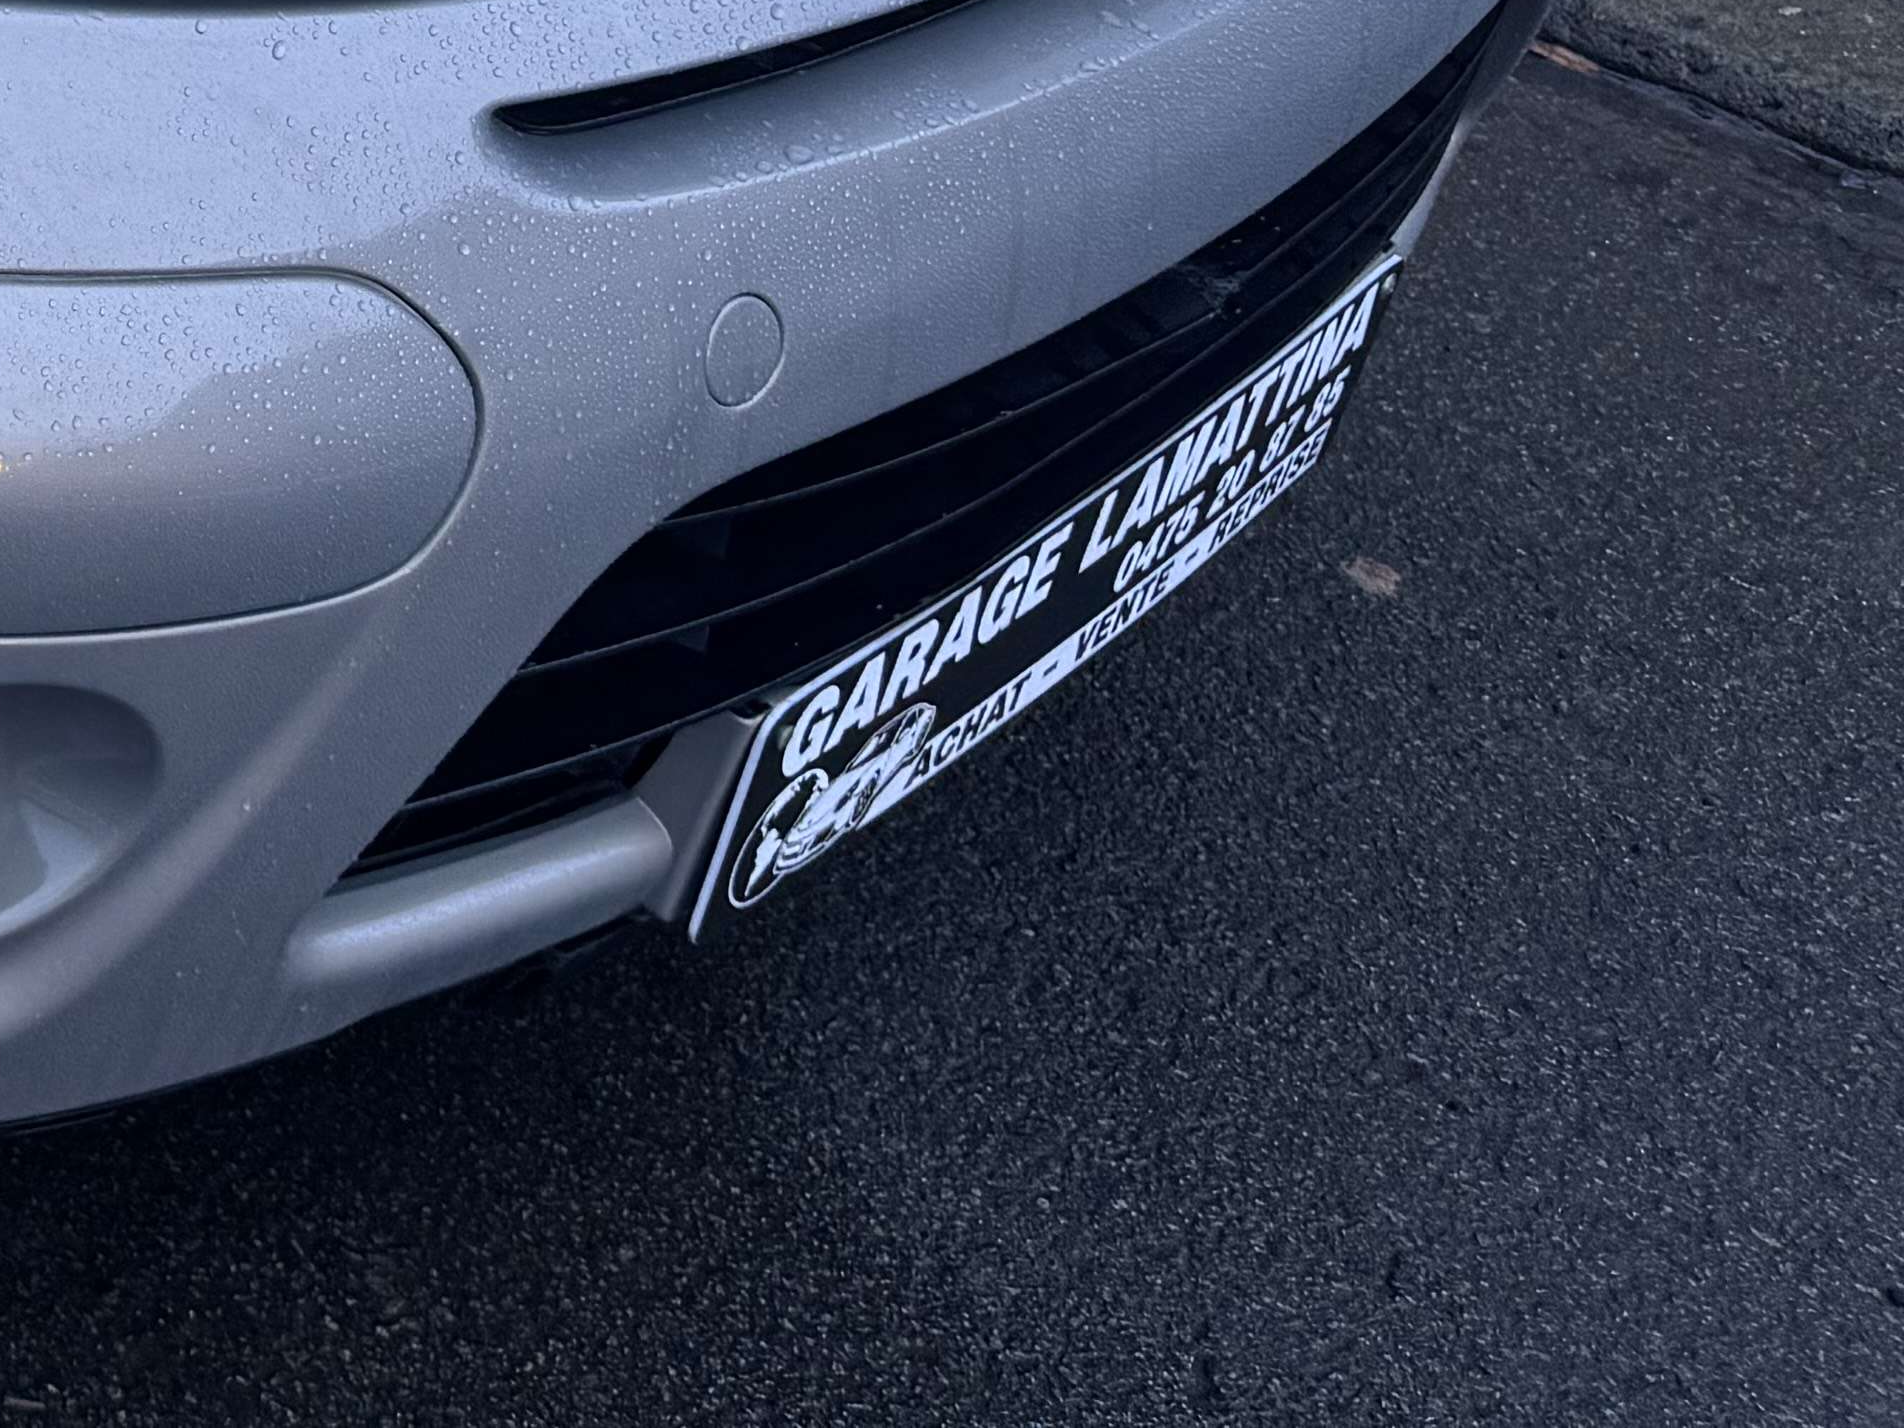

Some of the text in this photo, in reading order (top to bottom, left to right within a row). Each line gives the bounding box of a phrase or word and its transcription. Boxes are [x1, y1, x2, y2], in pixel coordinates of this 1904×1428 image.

[781, 281, 1380, 778] GARAGE LAMATTINA
[902, 672, 1031, 791] ACHAT
[1072, 559, 1175, 663] VENTE
[1207, 425, 1332, 555] REPRISE
[1113, 364, 1351, 593] 0475 20 87 85
